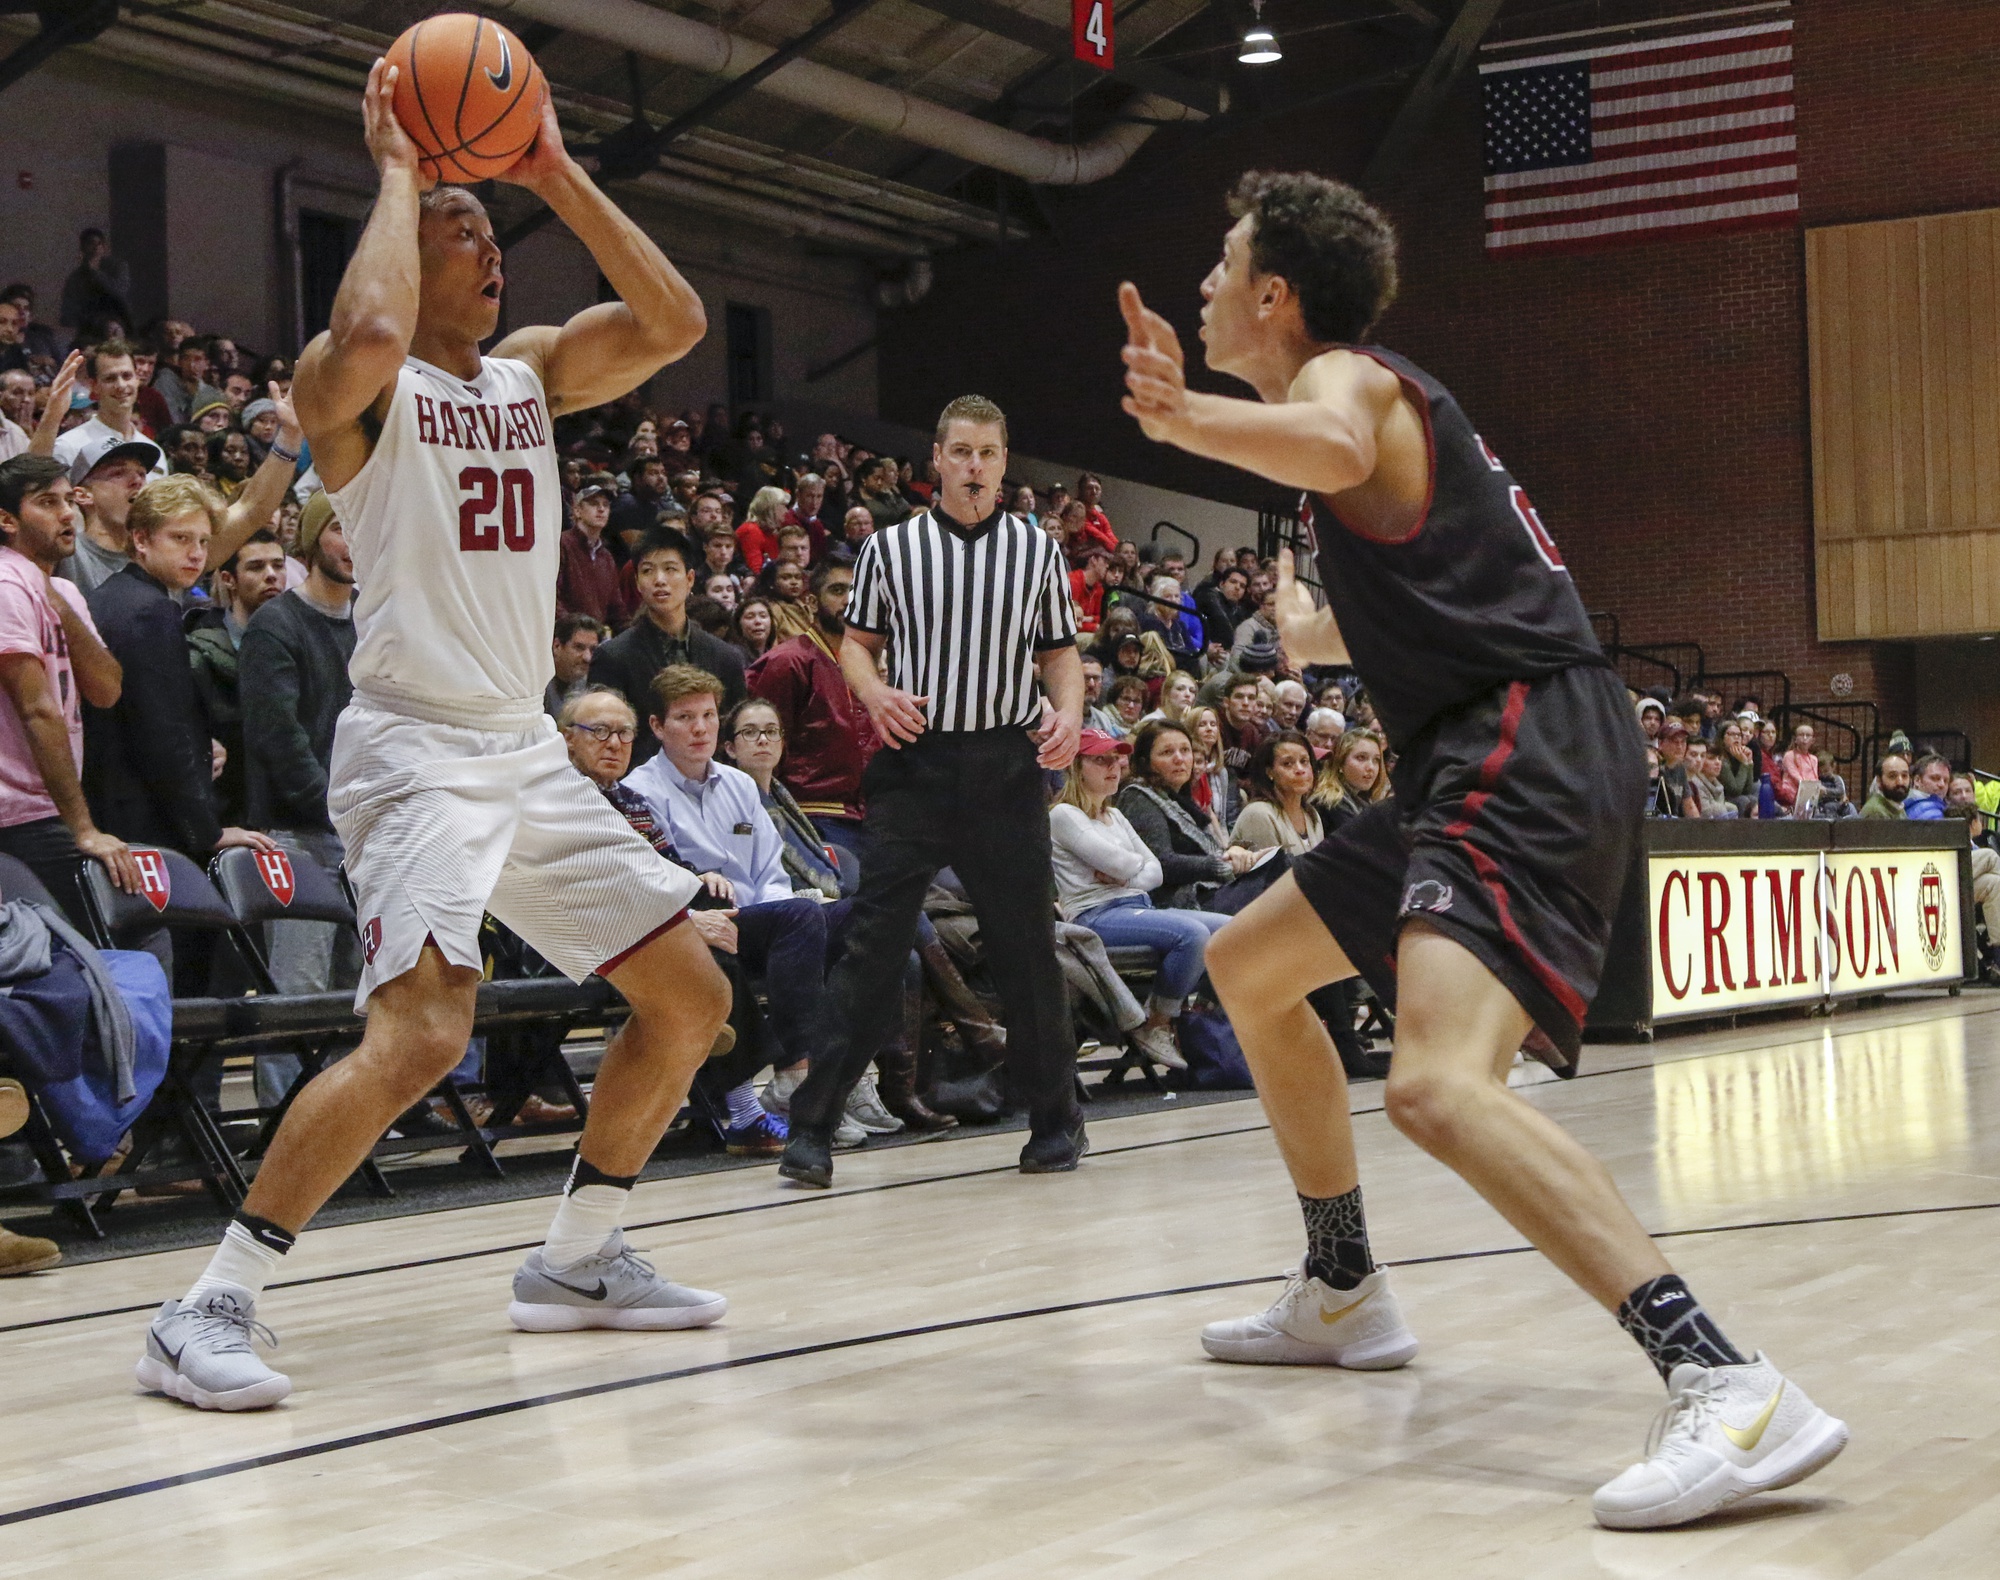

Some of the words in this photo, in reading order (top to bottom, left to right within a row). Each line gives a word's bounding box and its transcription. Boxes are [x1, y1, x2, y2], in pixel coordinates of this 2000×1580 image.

[1086, 1, 1107, 56] 4
[415, 393, 546, 452] HARVARD
[459, 466, 535, 552] 20
[135, 855, 165, 892] H
[262, 854, 290, 889] H
[363, 923, 376, 957] H
[1659, 866, 1900, 1000] CRIMSON
